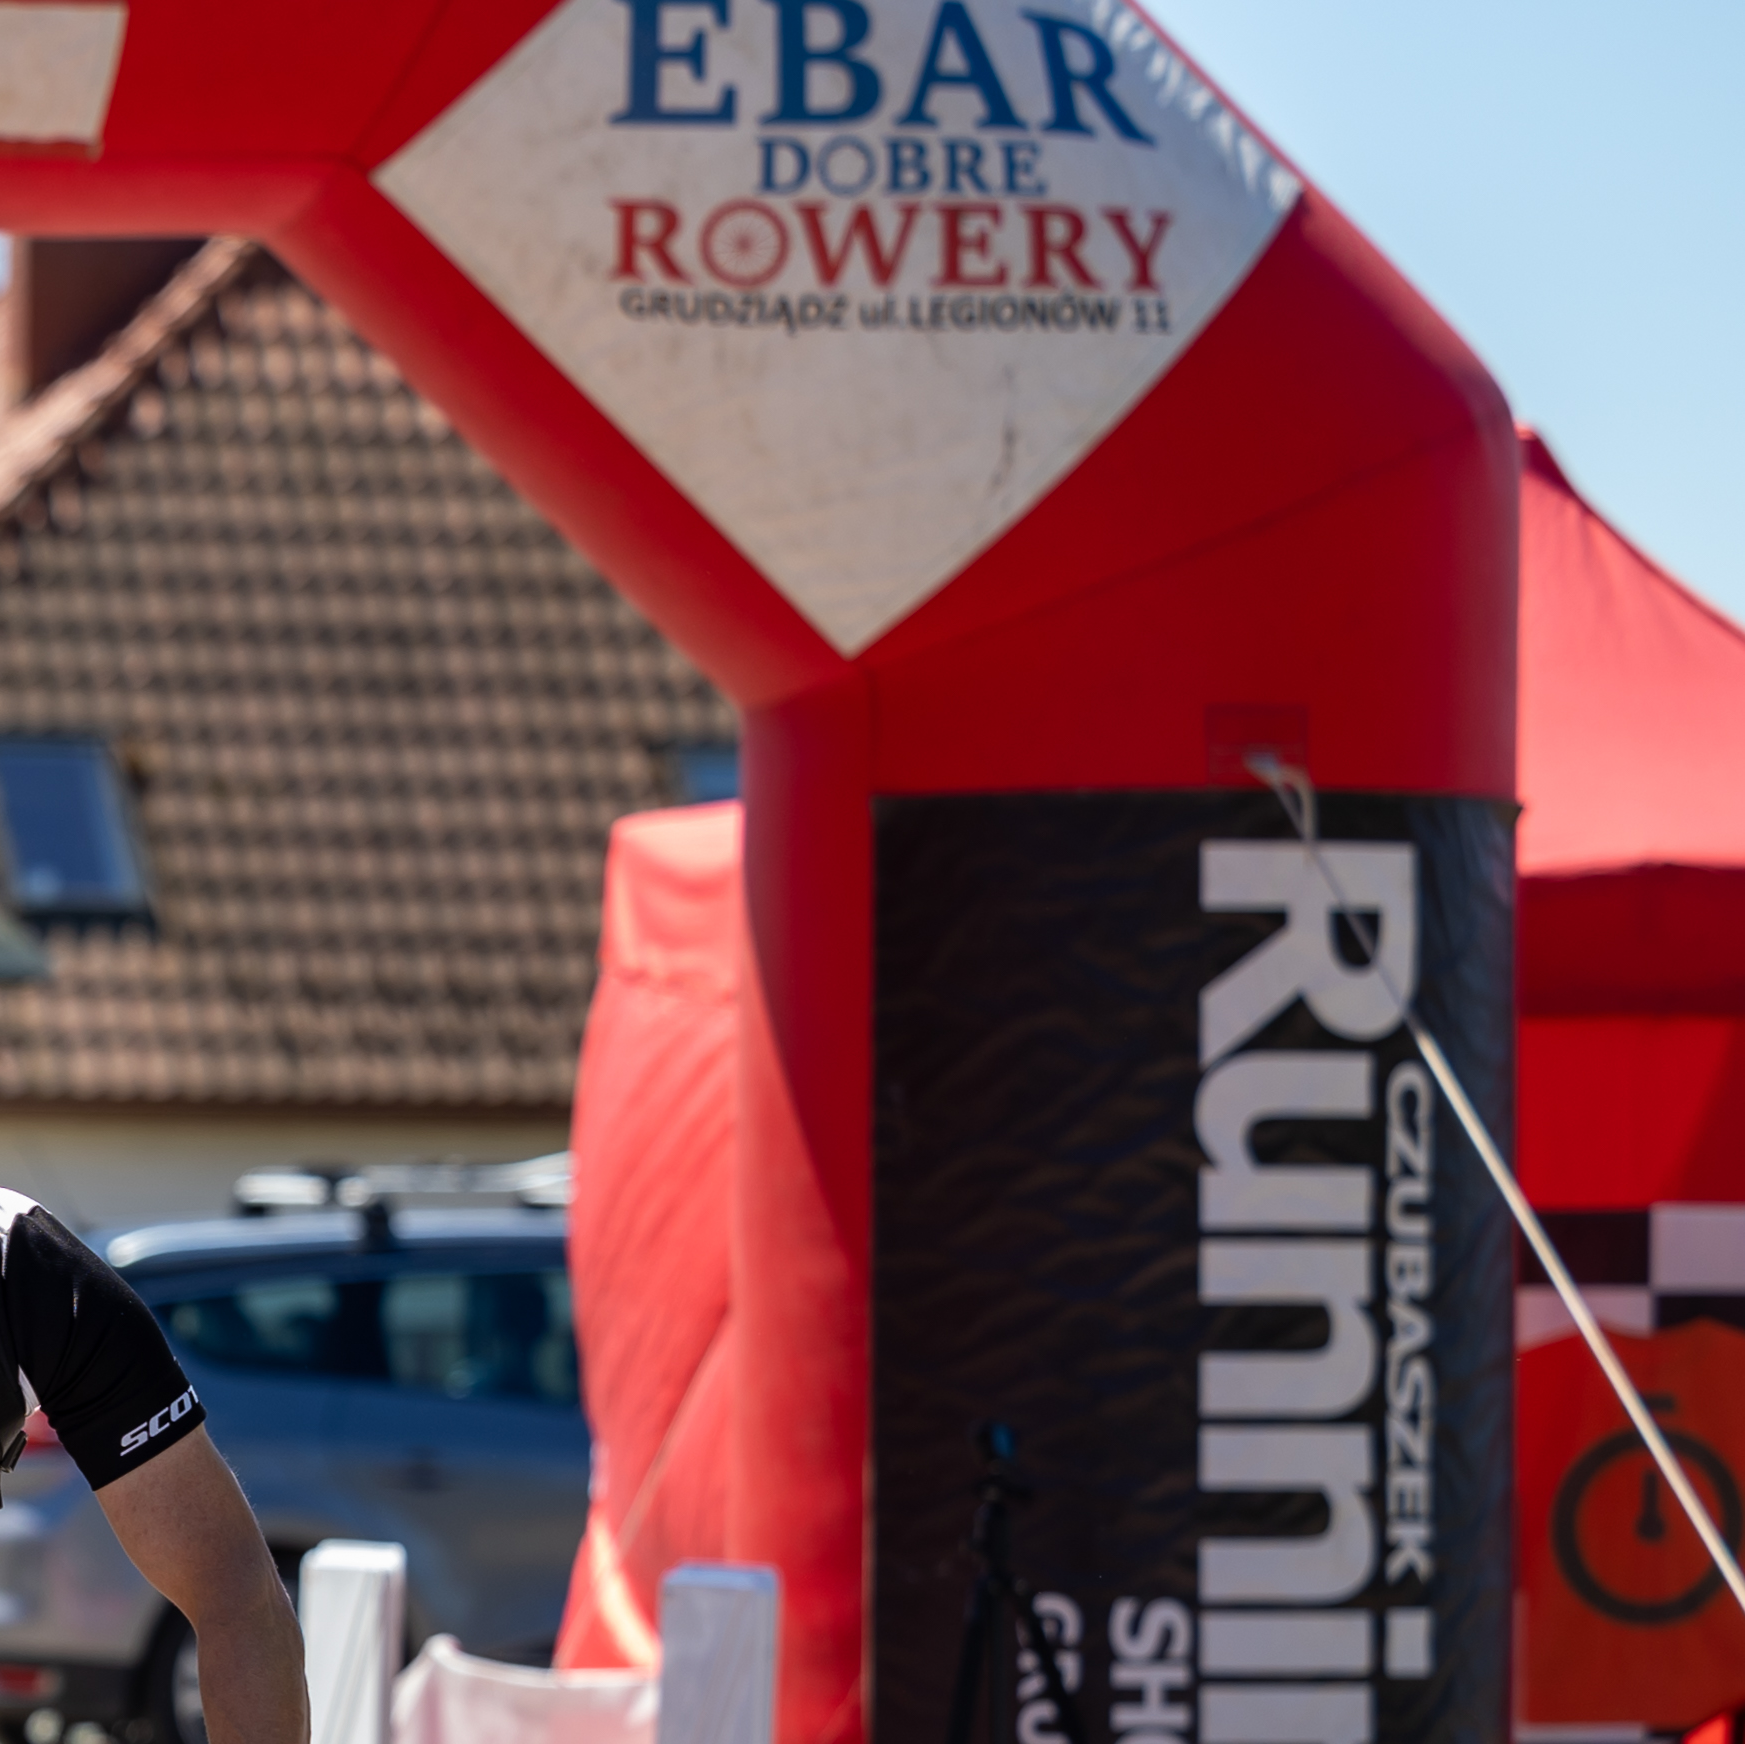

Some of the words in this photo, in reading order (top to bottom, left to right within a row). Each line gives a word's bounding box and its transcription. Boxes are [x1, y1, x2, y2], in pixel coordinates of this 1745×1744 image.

[608, 0, 1158, 148] EBAR
[755, 134, 1049, 198] DOBRE
[605, 196, 1174, 295] ROWERY
[1132, 300, 1172, 334] 11
[1384, 1061, 1435, 1582] CZUBASZEK
